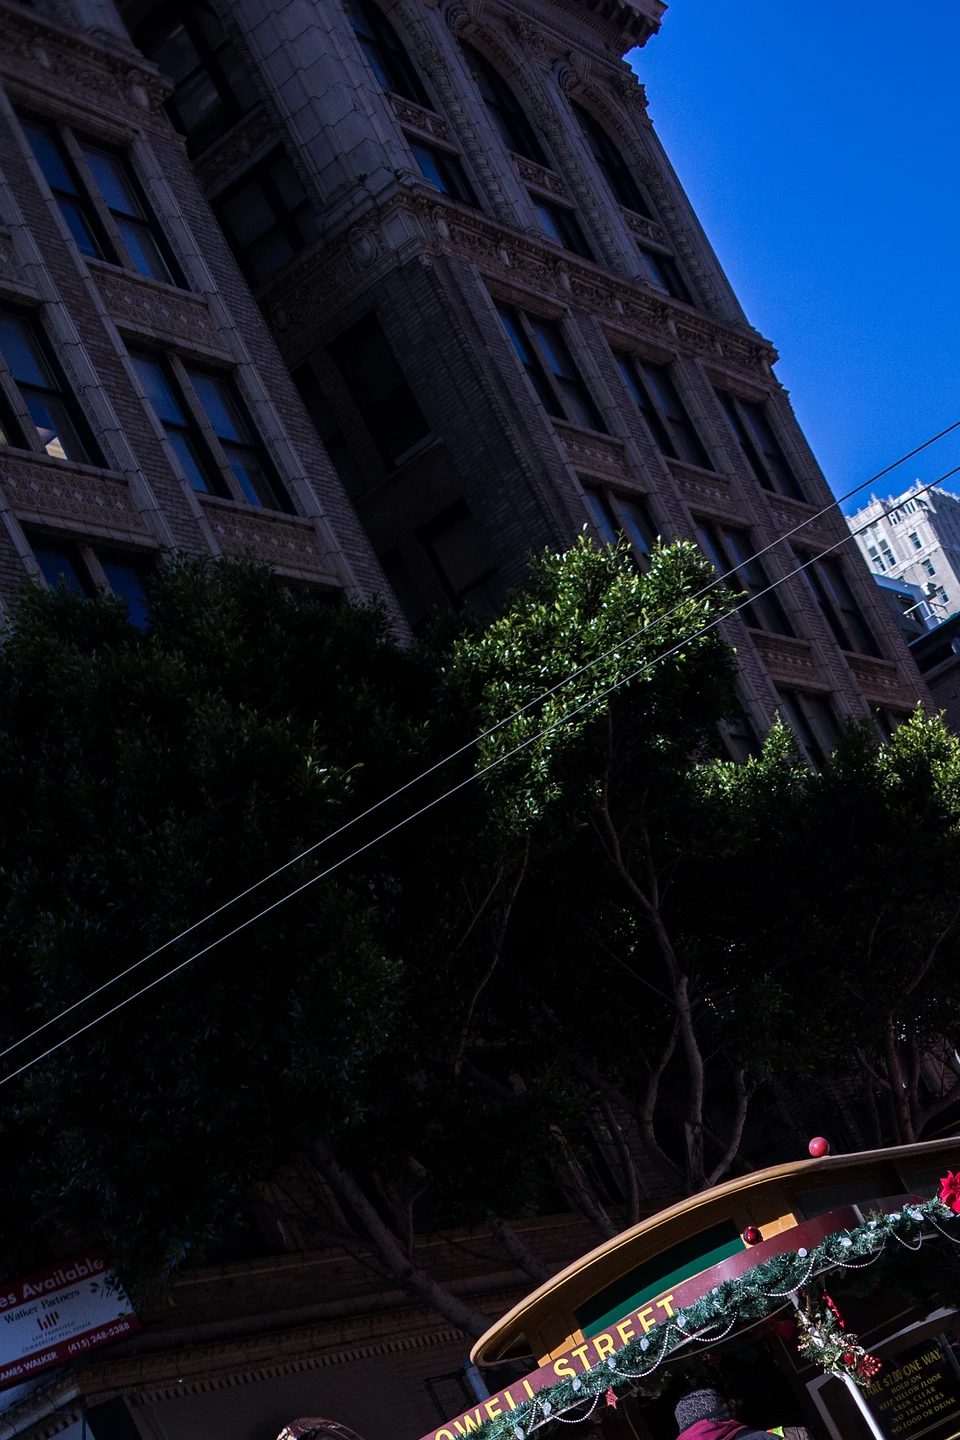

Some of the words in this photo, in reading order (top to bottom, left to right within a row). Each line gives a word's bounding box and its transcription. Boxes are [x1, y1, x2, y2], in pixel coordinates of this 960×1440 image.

[22, 1257, 105, 1300] Available
[4, 1305, 38, 1324] Walker
[41, 1289, 81, 1311] Partners
[23, 1351, 59, 1371] WALKER
[67, 1337, 91, 1355] (415)
[90, 1321, 131, 1345] 248-5388
[553, 1294, 675, 1379] STREET
[883, 1368, 904, 1388] $7.00
[903, 1358, 923, 1377] ONE
[921, 1347, 943, 1367] WAY
[890, 1380, 910, 1394] HOLD
[911, 1373, 923, 1384] ON
[892, 1400, 912, 1413] AREA
[913, 1386, 937, 1402] CLEAR
[894, 1384, 920, 1402] YELLOW
[920, 1372, 943, 1388] FLOOR
[891, 1425, 902, 1435] NO
[902, 1414, 923, 1430] FOOD
[922, 1407, 934, 1419] OR
[934, 1396, 957, 1413] DRINK
[893, 1413, 905, 1423] NO
[905, 1391, 945, 1417] TRANSFERS
